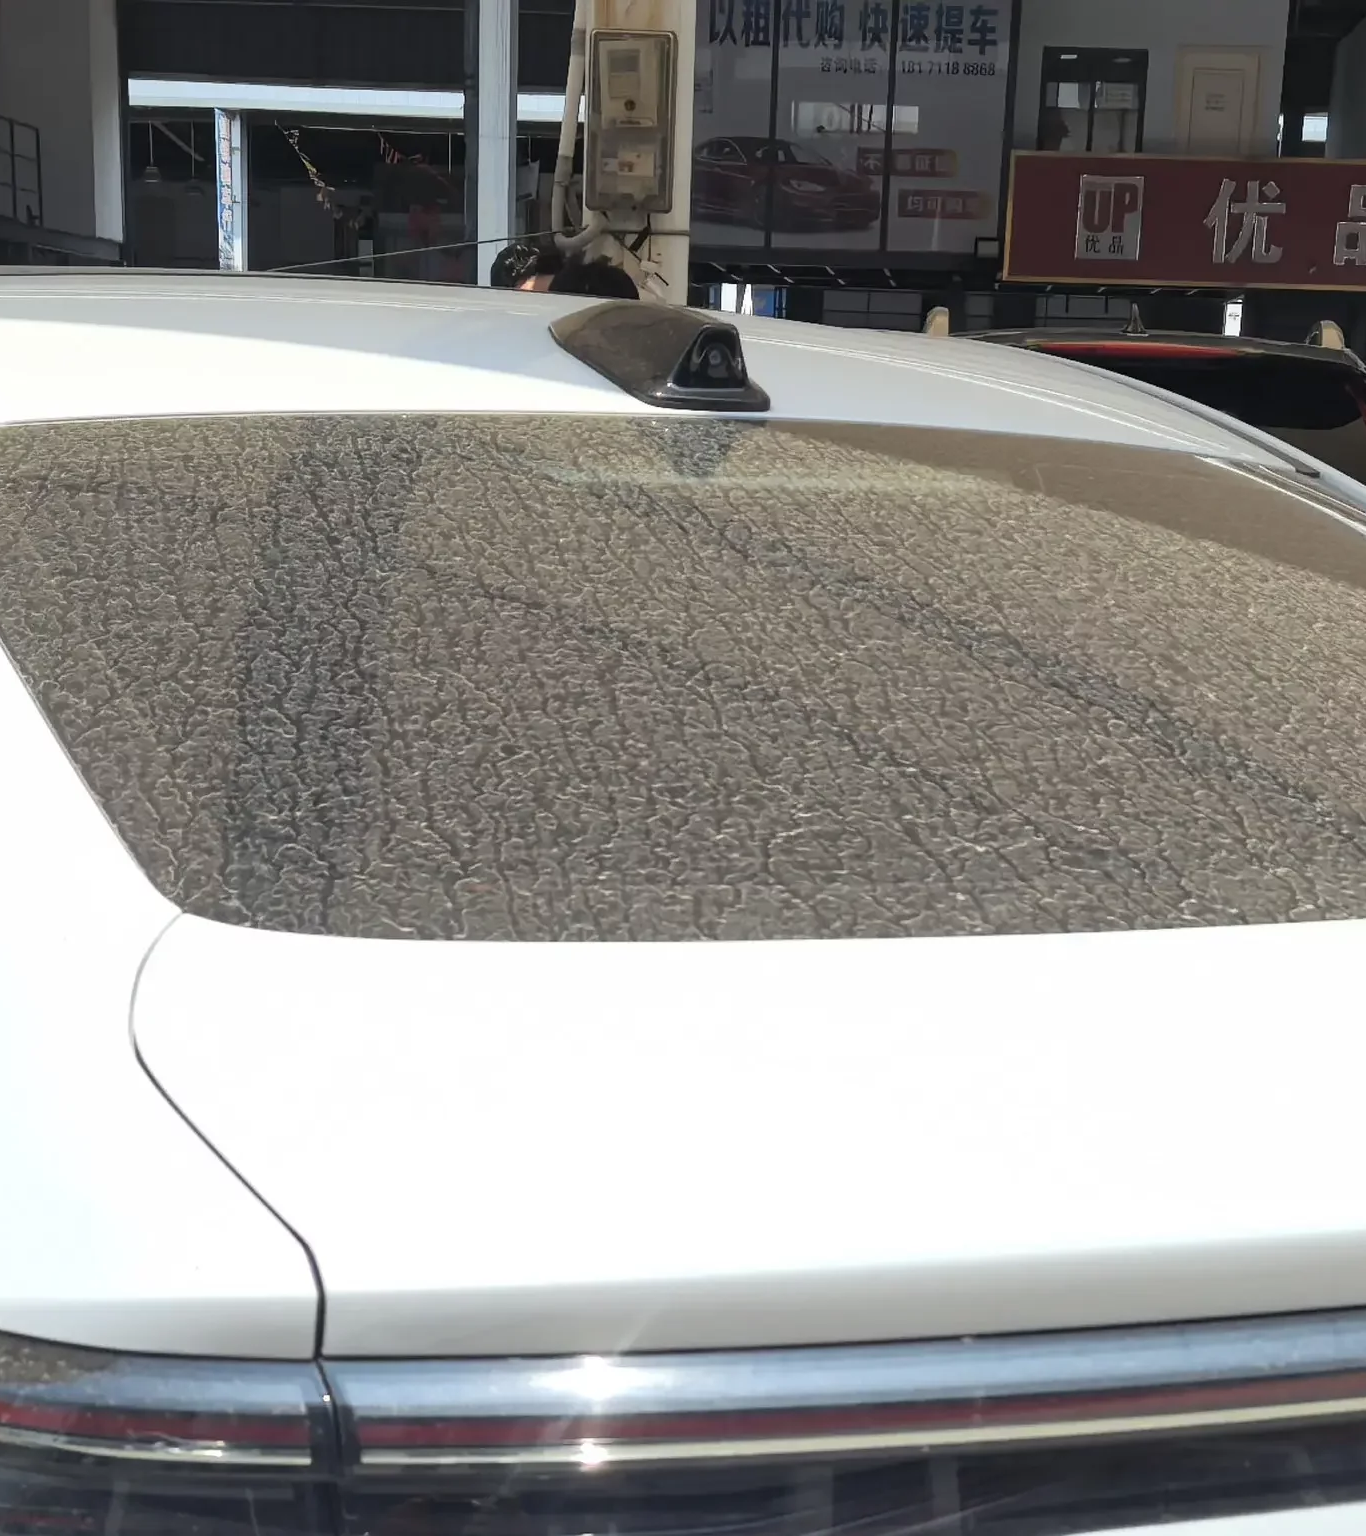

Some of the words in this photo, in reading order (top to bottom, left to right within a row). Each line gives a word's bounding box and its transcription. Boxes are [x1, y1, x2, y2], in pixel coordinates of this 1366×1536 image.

[708, 0, 845, 48] 以租代购
[1081, 182, 1139, 233] UP
[1085, 234, 1124, 255] 优品
